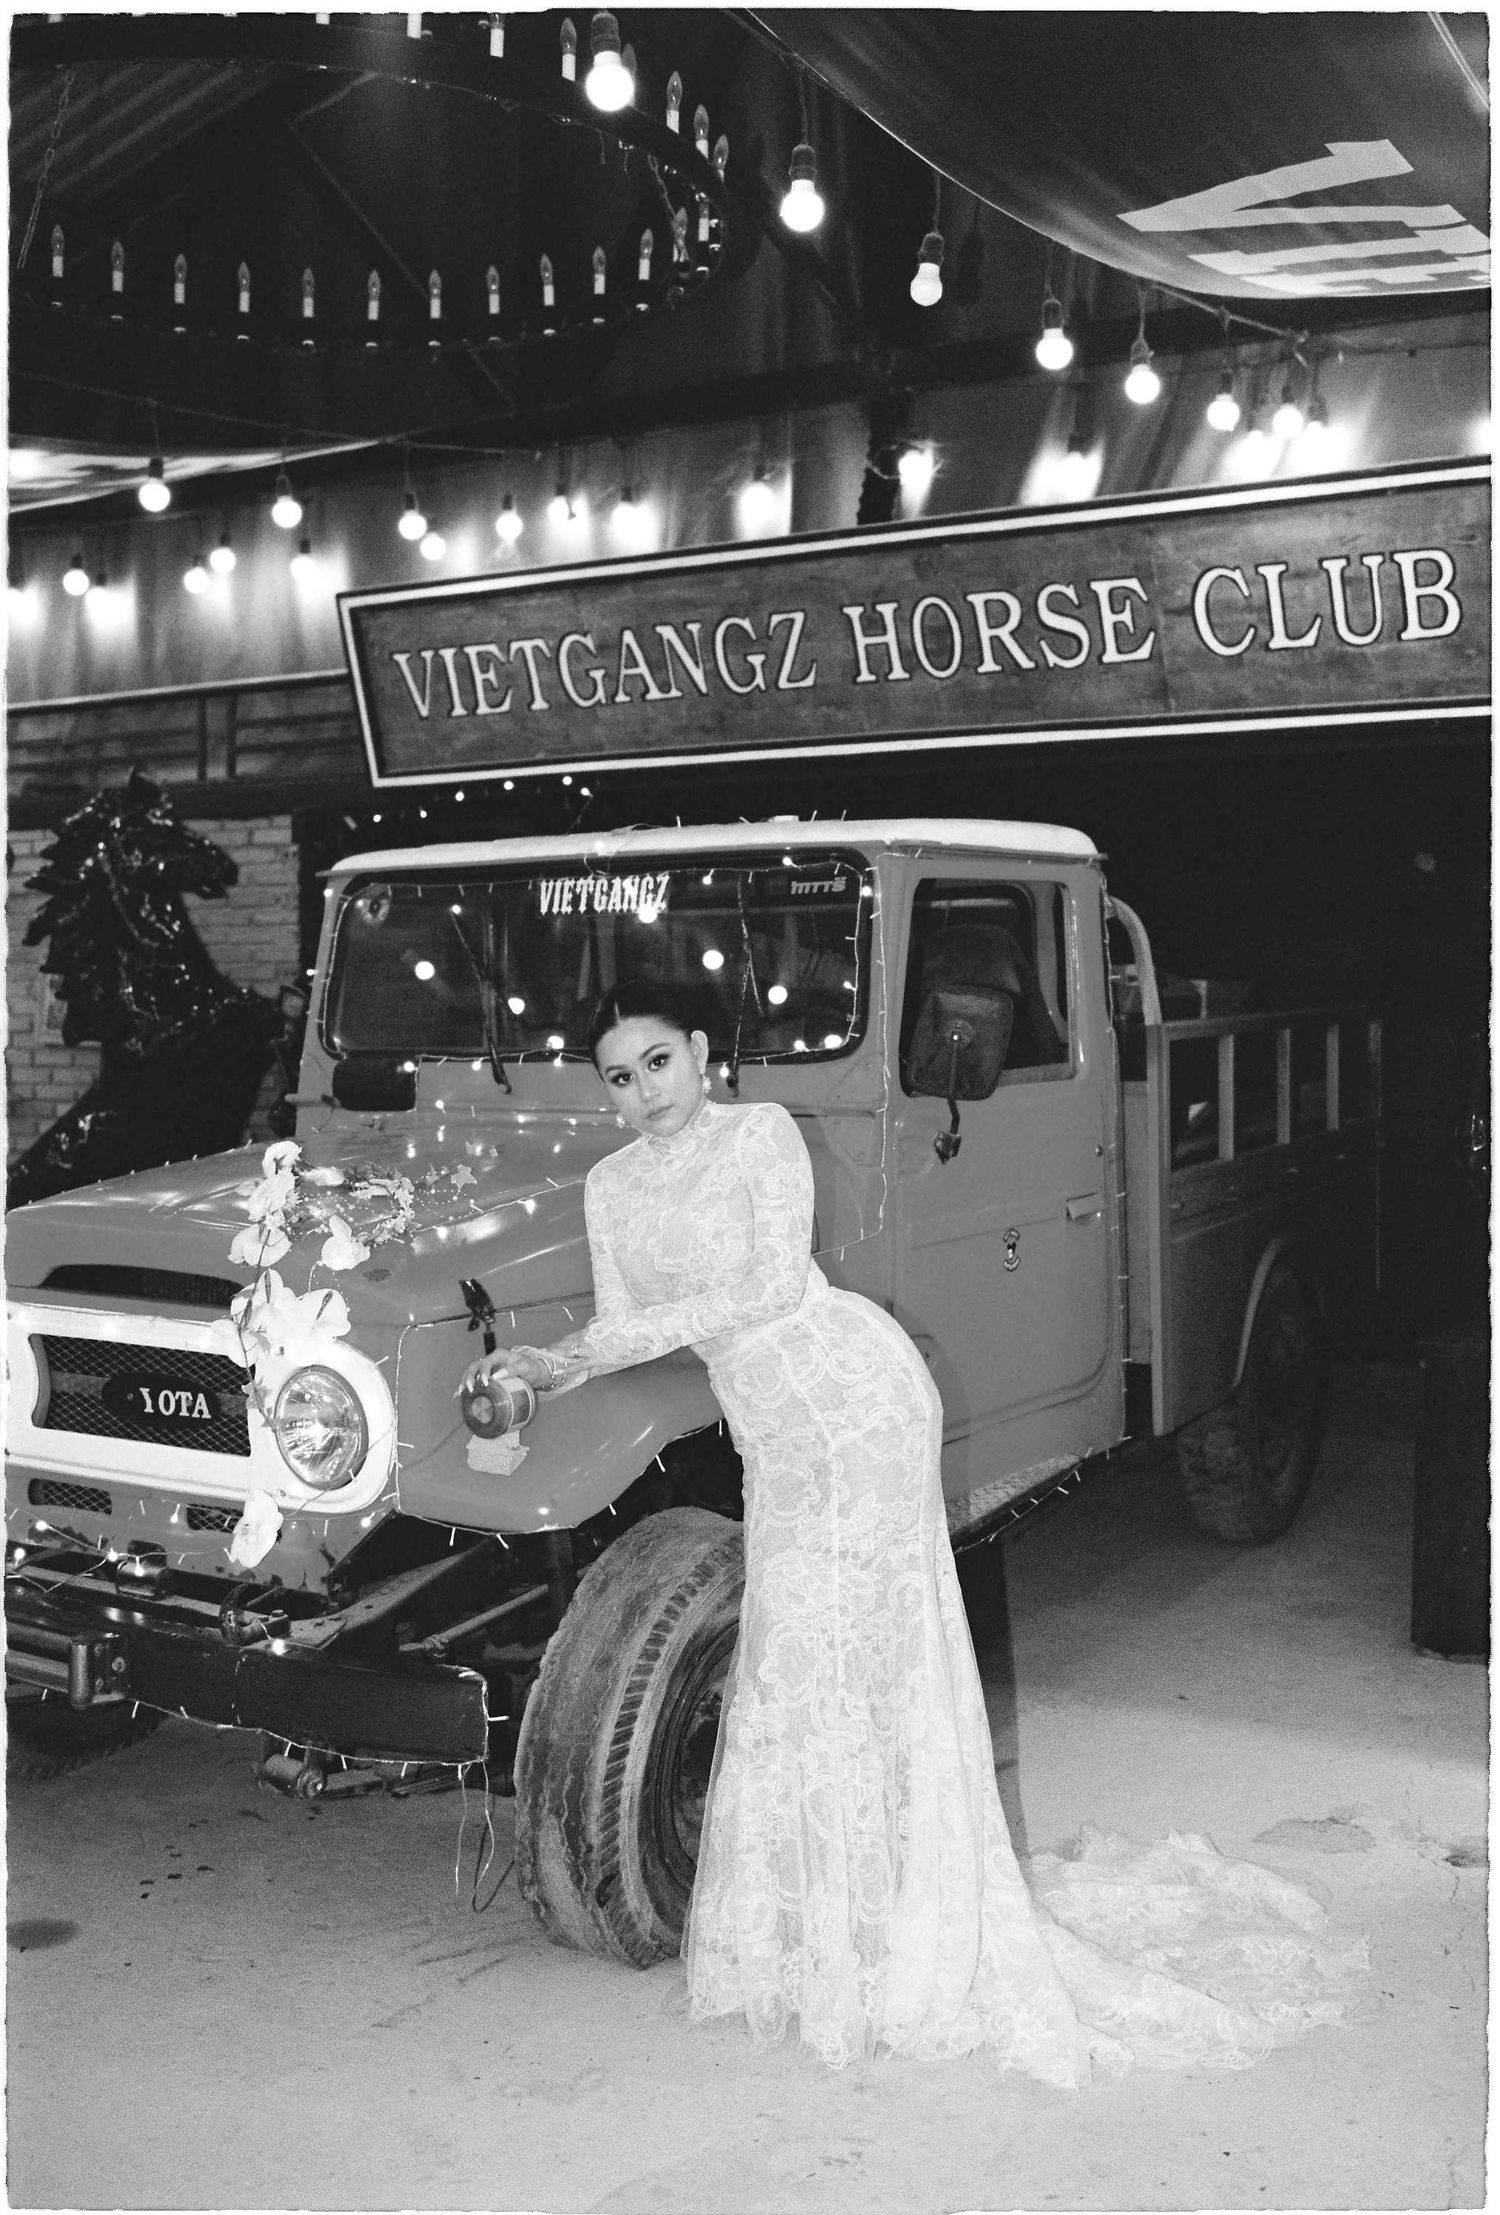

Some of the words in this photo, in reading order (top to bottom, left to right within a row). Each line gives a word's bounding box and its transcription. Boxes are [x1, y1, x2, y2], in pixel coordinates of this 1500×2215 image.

[392, 610, 817, 718] VIETGANGZ
[842, 577, 1156, 683] HORSE
[1193, 549, 1463, 657] CLUB
[540, 874, 670, 915] VIETGANGZ
